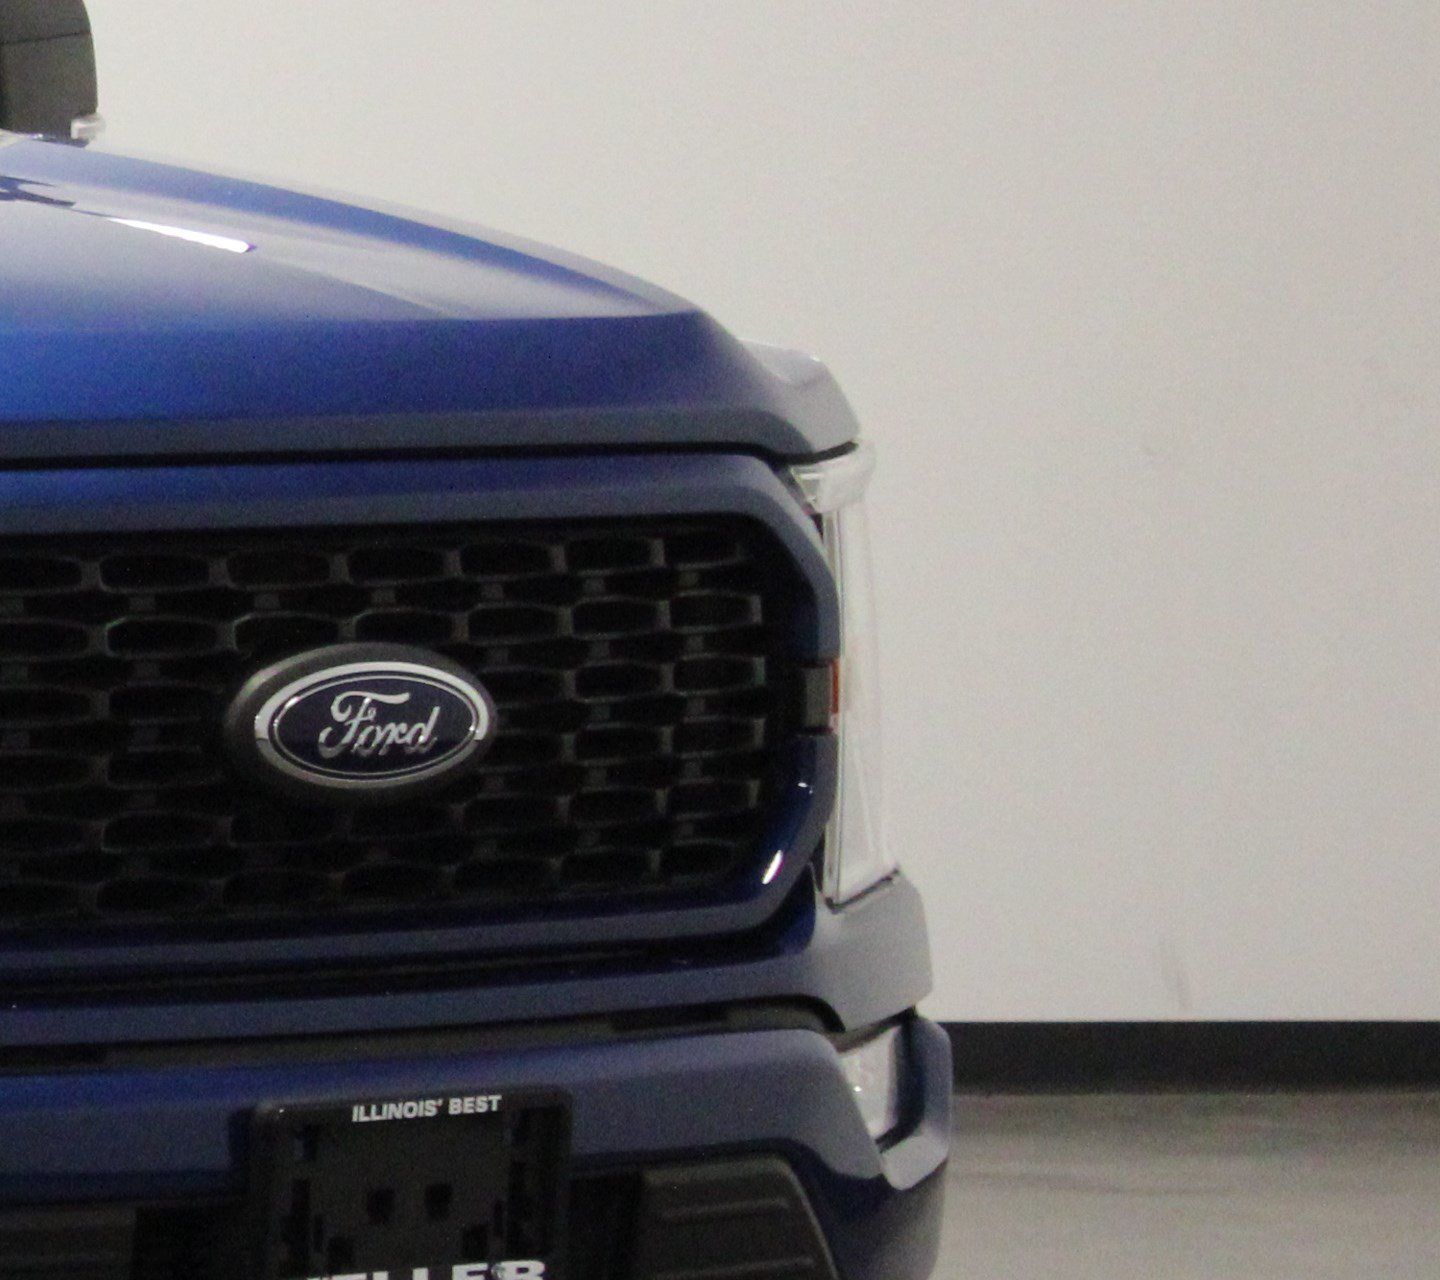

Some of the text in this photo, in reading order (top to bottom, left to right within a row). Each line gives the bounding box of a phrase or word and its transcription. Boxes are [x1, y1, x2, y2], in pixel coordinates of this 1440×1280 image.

[319, 690, 441, 758] Ford
[352, 1095, 502, 1122] ILLINOIS' BEST
